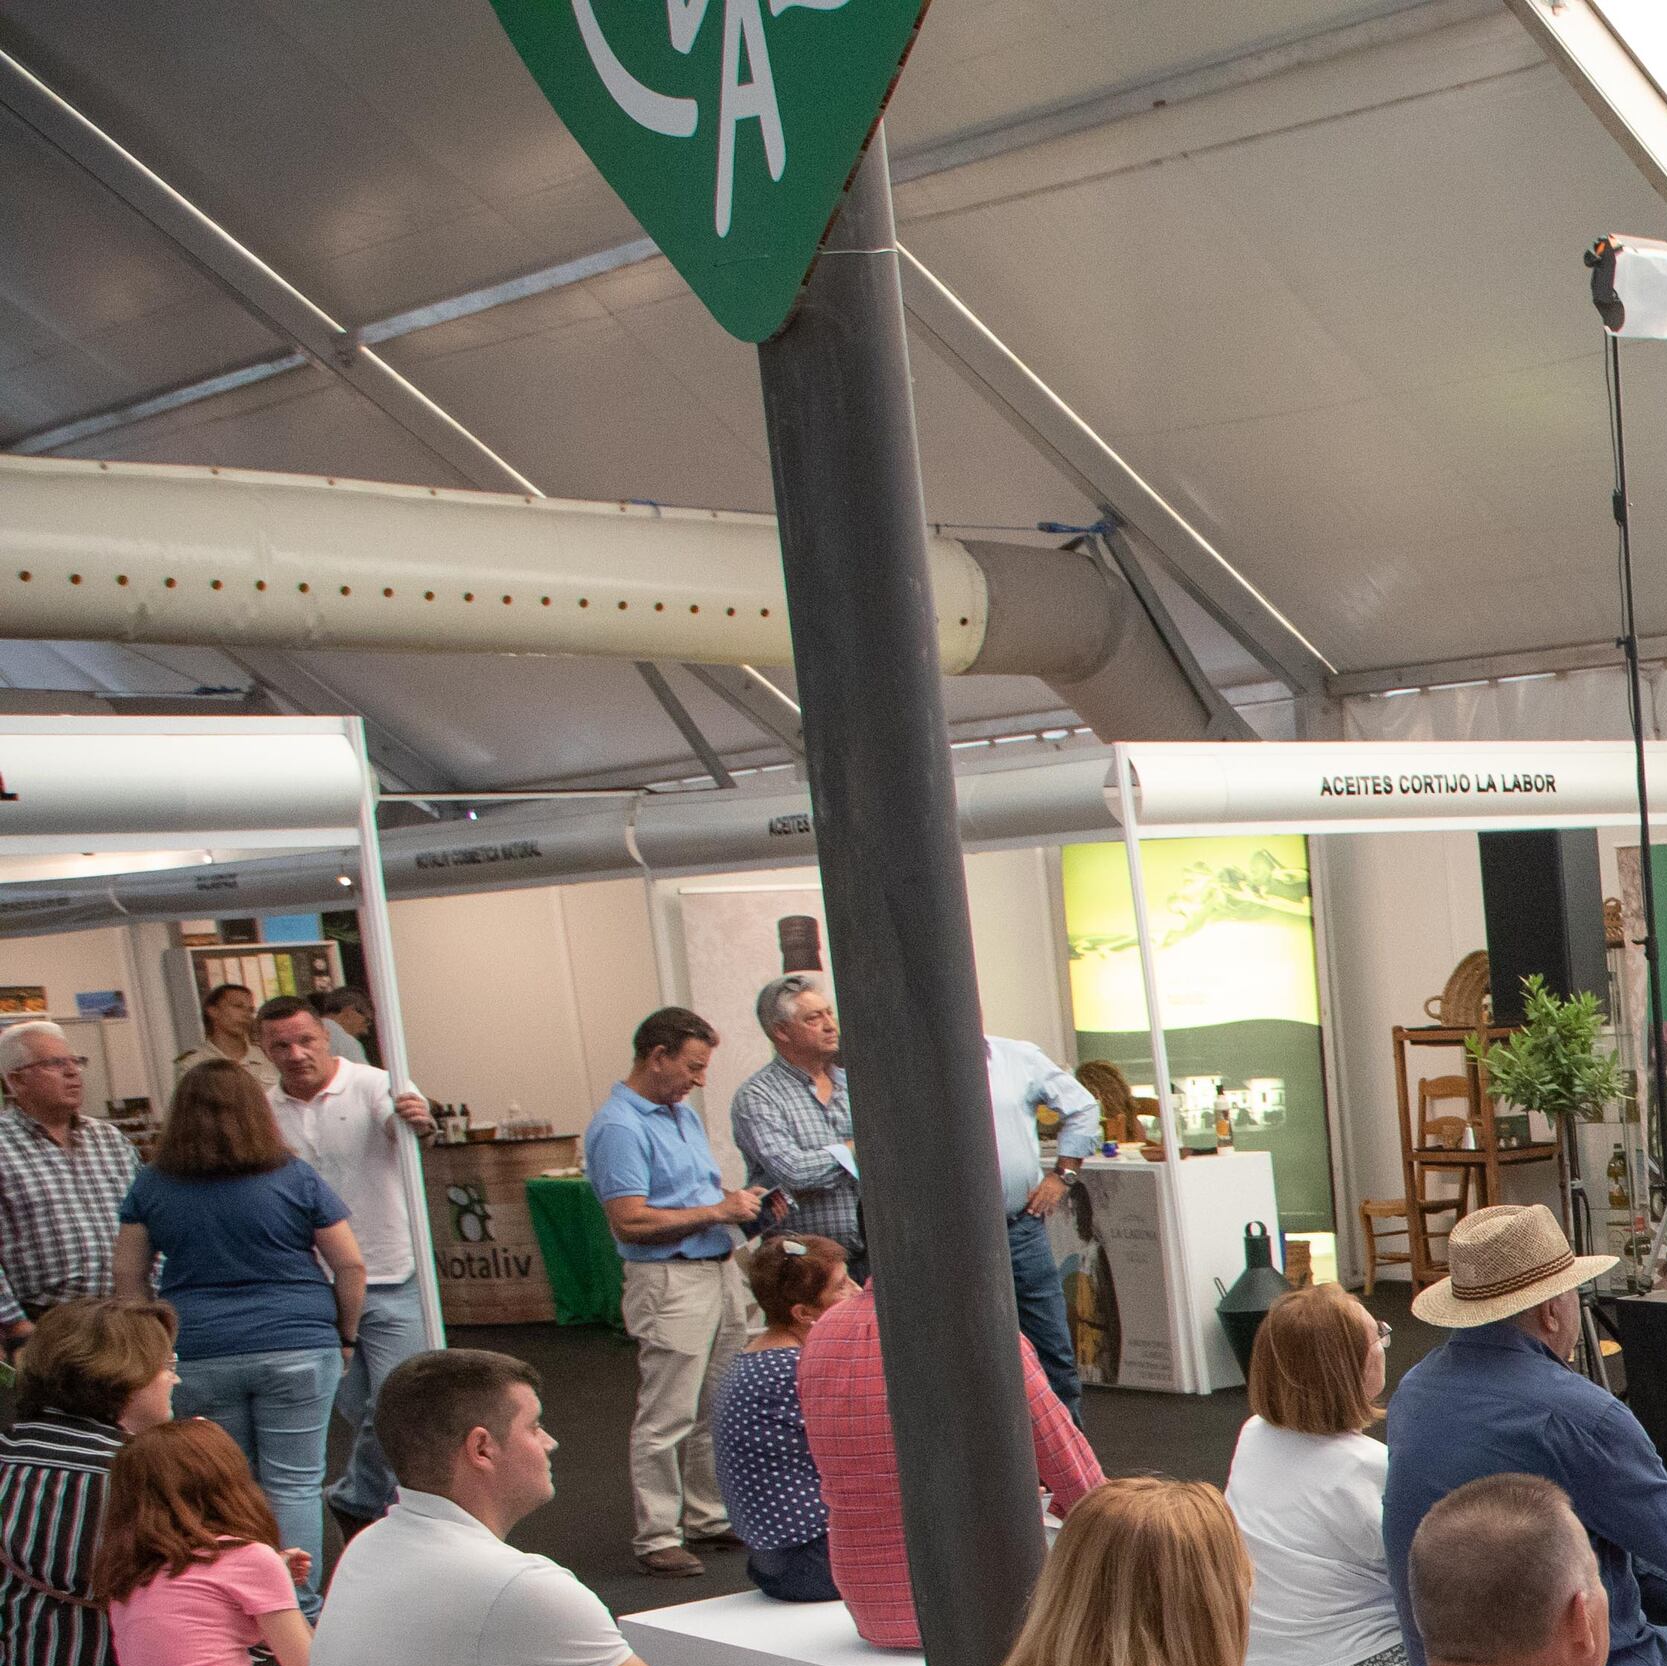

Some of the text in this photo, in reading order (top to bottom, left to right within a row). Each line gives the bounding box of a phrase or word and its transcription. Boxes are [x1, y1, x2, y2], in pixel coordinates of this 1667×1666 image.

[1320, 773, 1557, 797] ACEITES CORTIJO LA LABOR
